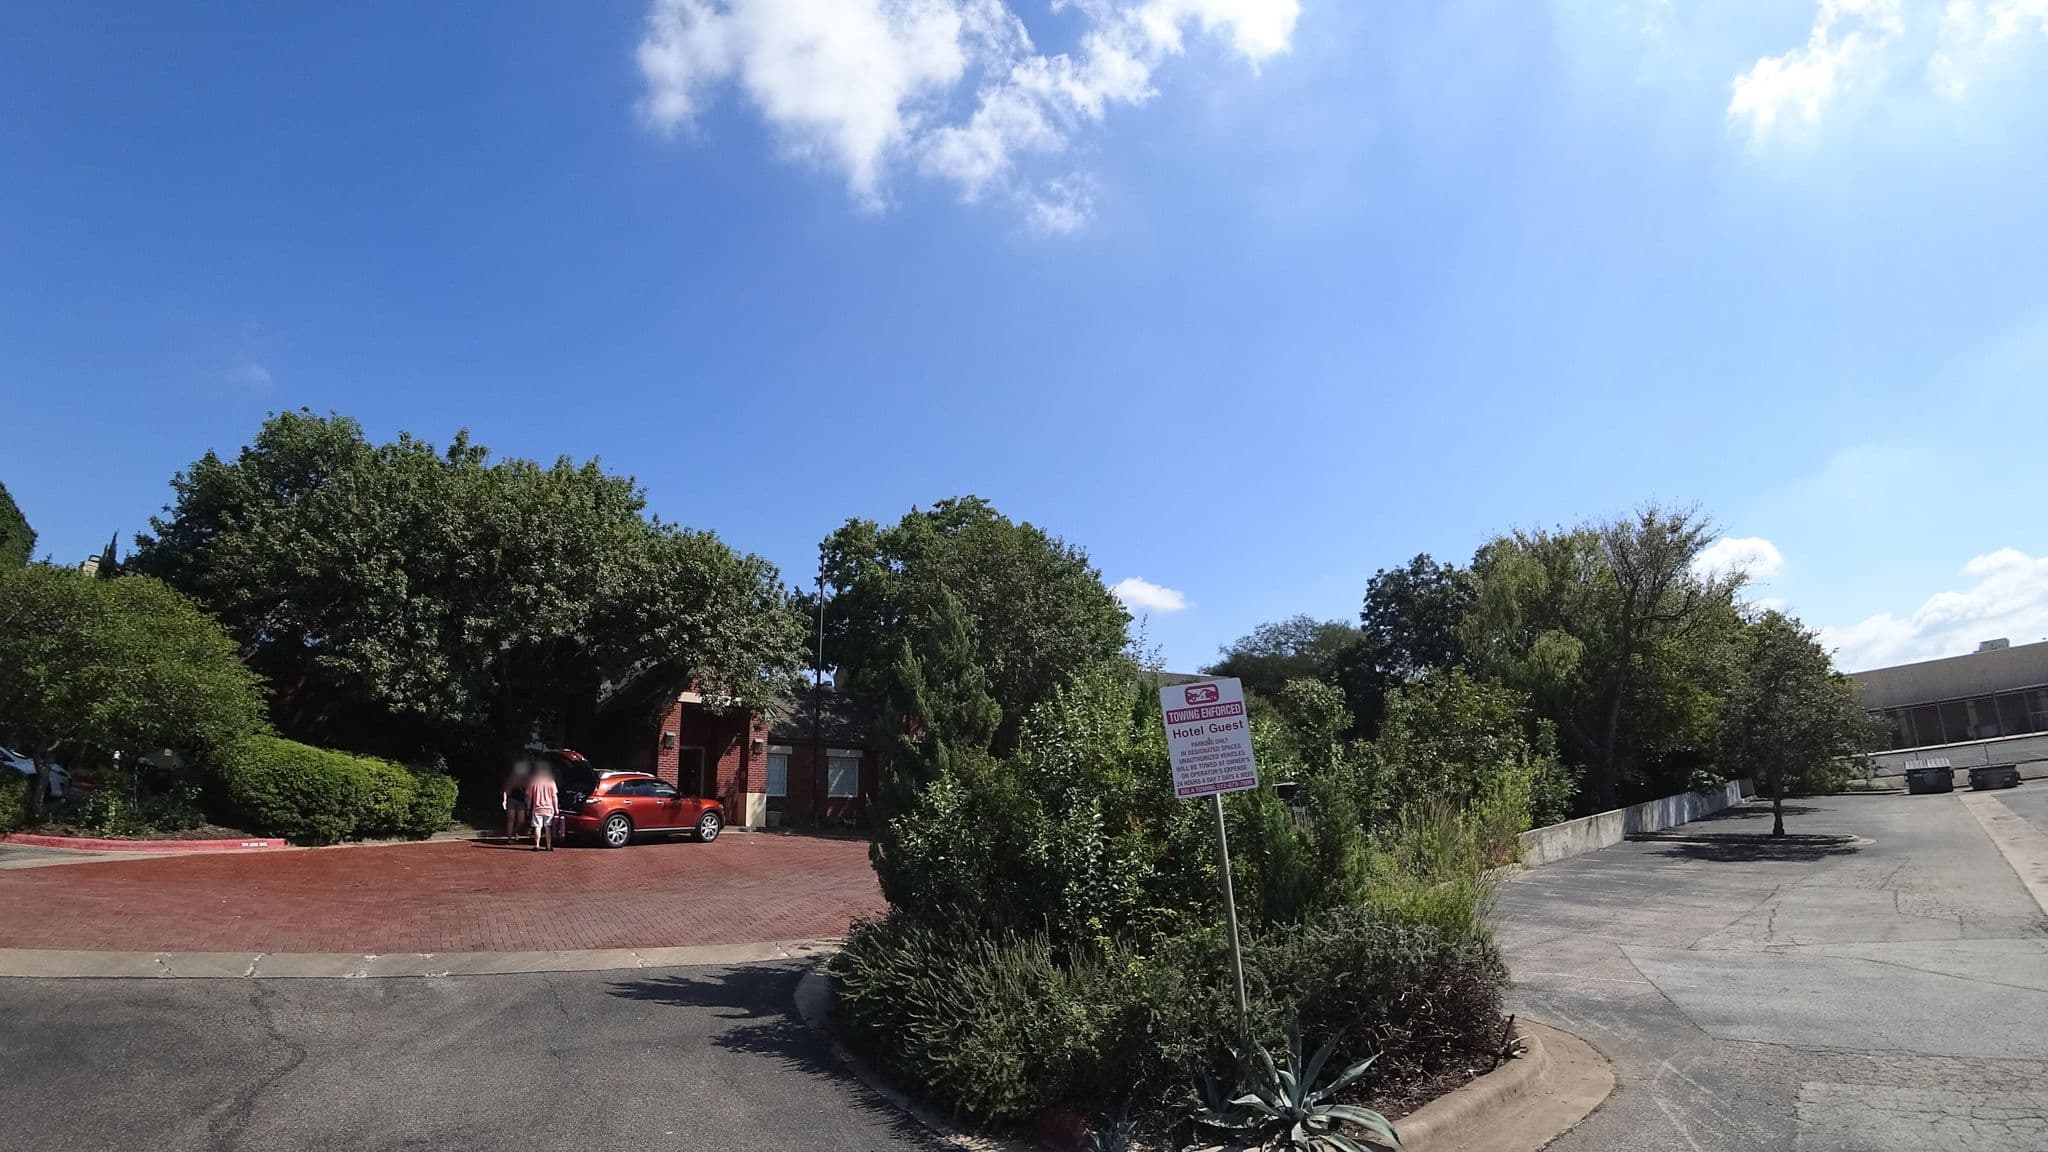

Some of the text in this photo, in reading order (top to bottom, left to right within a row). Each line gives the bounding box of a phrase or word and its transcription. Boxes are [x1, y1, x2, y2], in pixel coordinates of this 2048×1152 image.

[1168, 703, 1241, 723] TOWING ENFORCED
[1173, 720, 1244, 739] Hotel Guest
[1191, 740, 1214, 748] PARKING
[1188, 746, 1220, 756] DESIGNATED
[1221, 743, 1241, 751] SPACES
[1179, 750, 1245, 764] UNAUTHORIZED VEHICLES
[1199, 761, 1217, 769] TOWED
[1224, 765, 1247, 773] EXPENSE
[1184, 778, 1200, 786] HOURS
